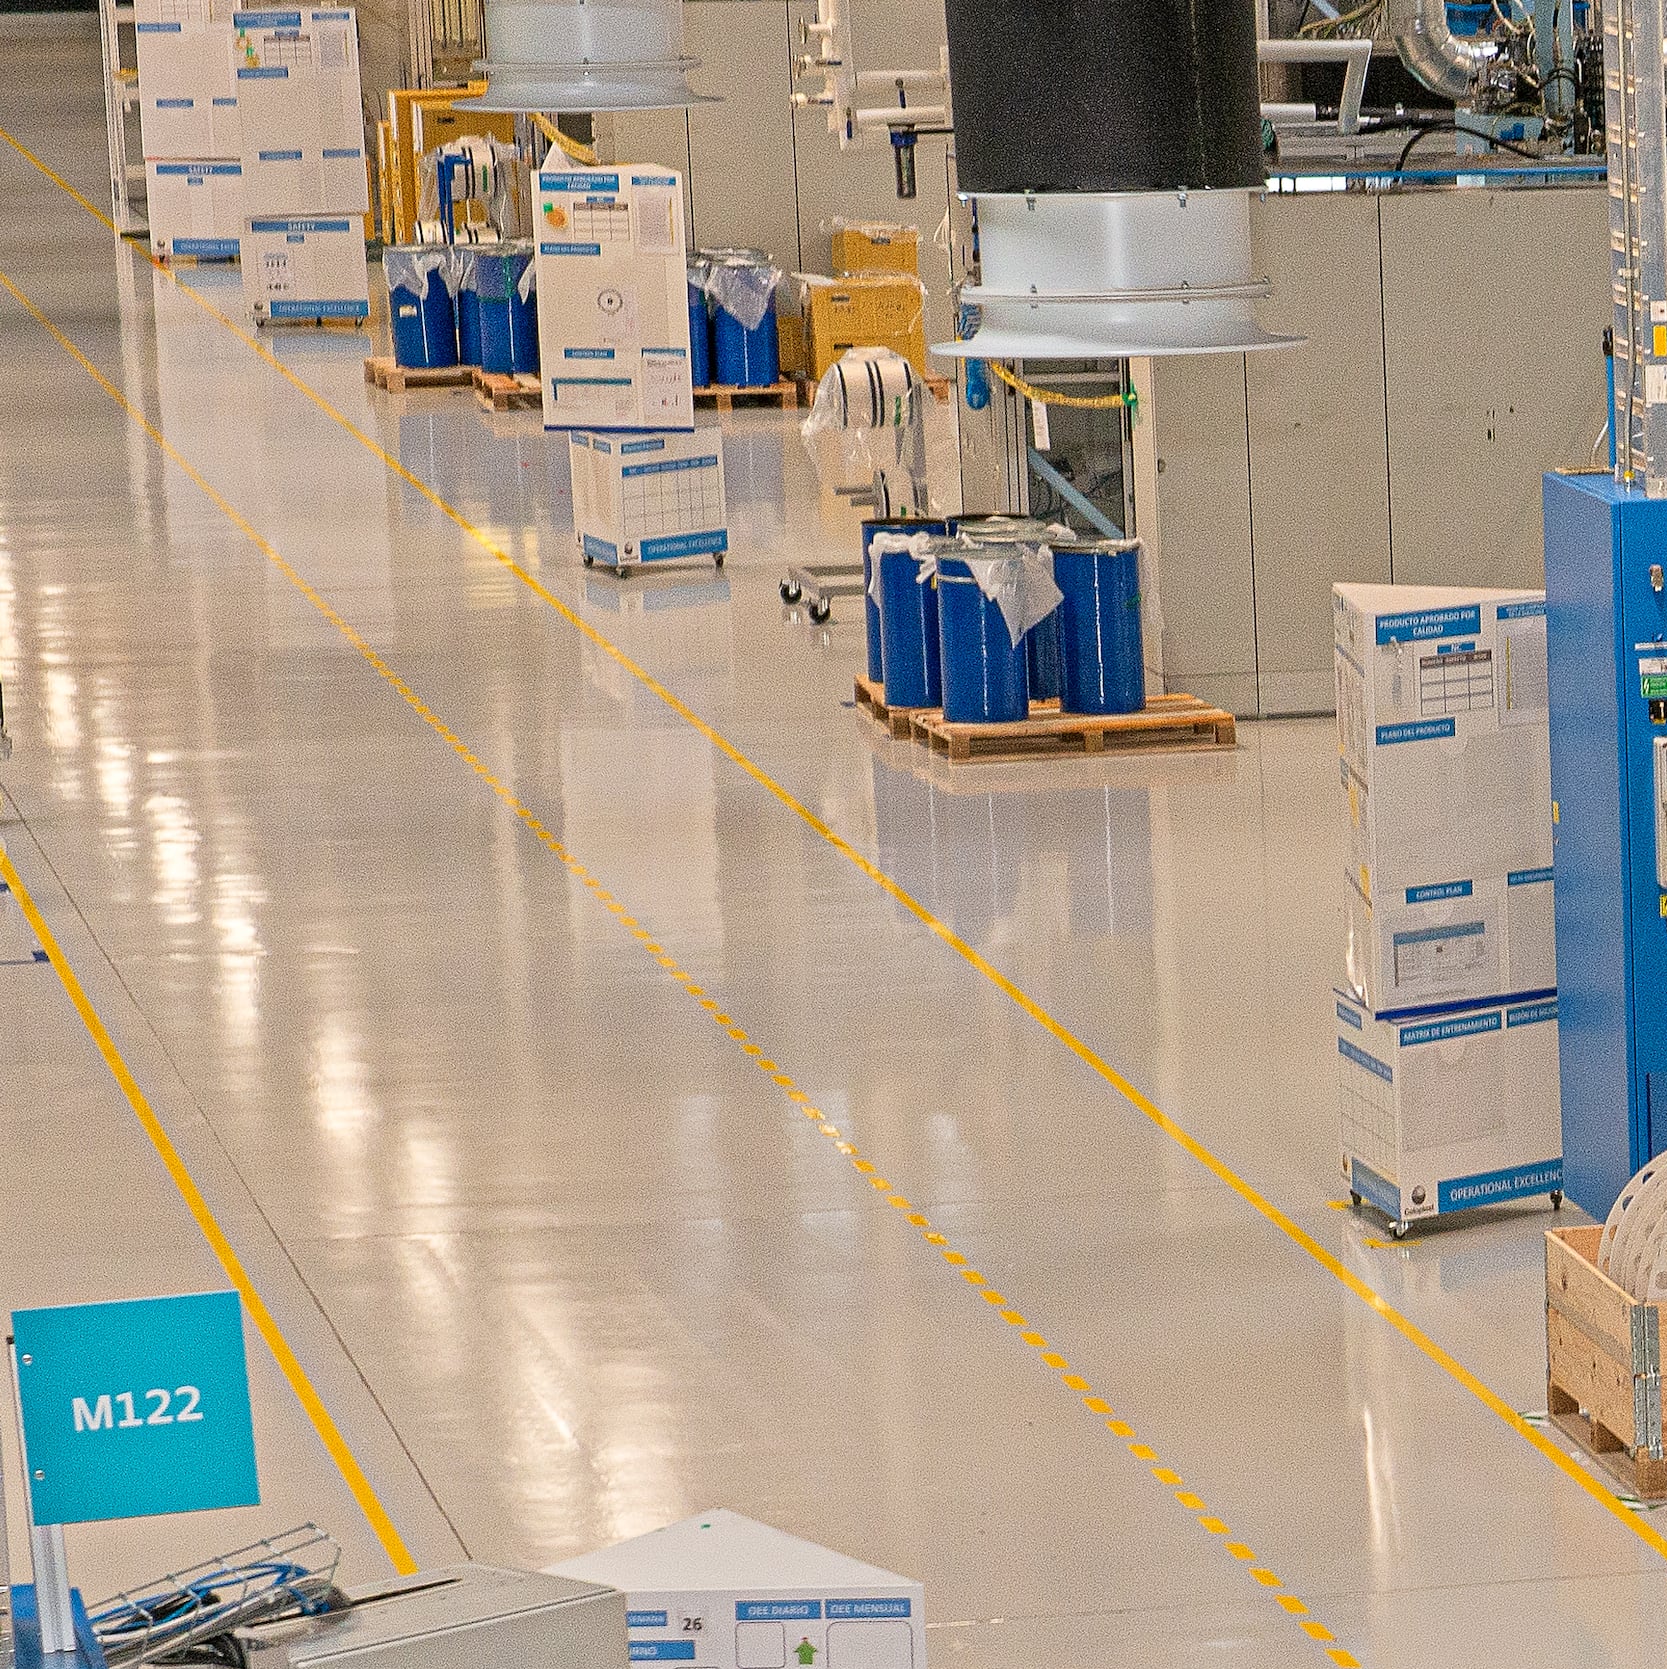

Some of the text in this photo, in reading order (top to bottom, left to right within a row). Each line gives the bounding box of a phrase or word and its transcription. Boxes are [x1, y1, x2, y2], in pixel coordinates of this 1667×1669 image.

[1379, 610, 1475, 629] PRODUCTO APROBADO POR
[1413, 625, 1443, 636] CALIDAD
[1403, 726, 1415, 736] DEL
[1416, 723, 1451, 735] PRODUCTO
[1416, 885, 1462, 899] CONTROL PLAN
[1404, 1019, 1498, 1041] MATRIX DE ENTRENAMIENTO
[1451, 1169, 1563, 1201] OPERATIONAL EXCELLENC
[72, 1385, 204, 1433] M122
[748, 1605, 809, 1615] OEE DIARIO
[830, 1603, 906, 1614] OEE MENSUAL
[682, 1617, 703, 1631] 26
